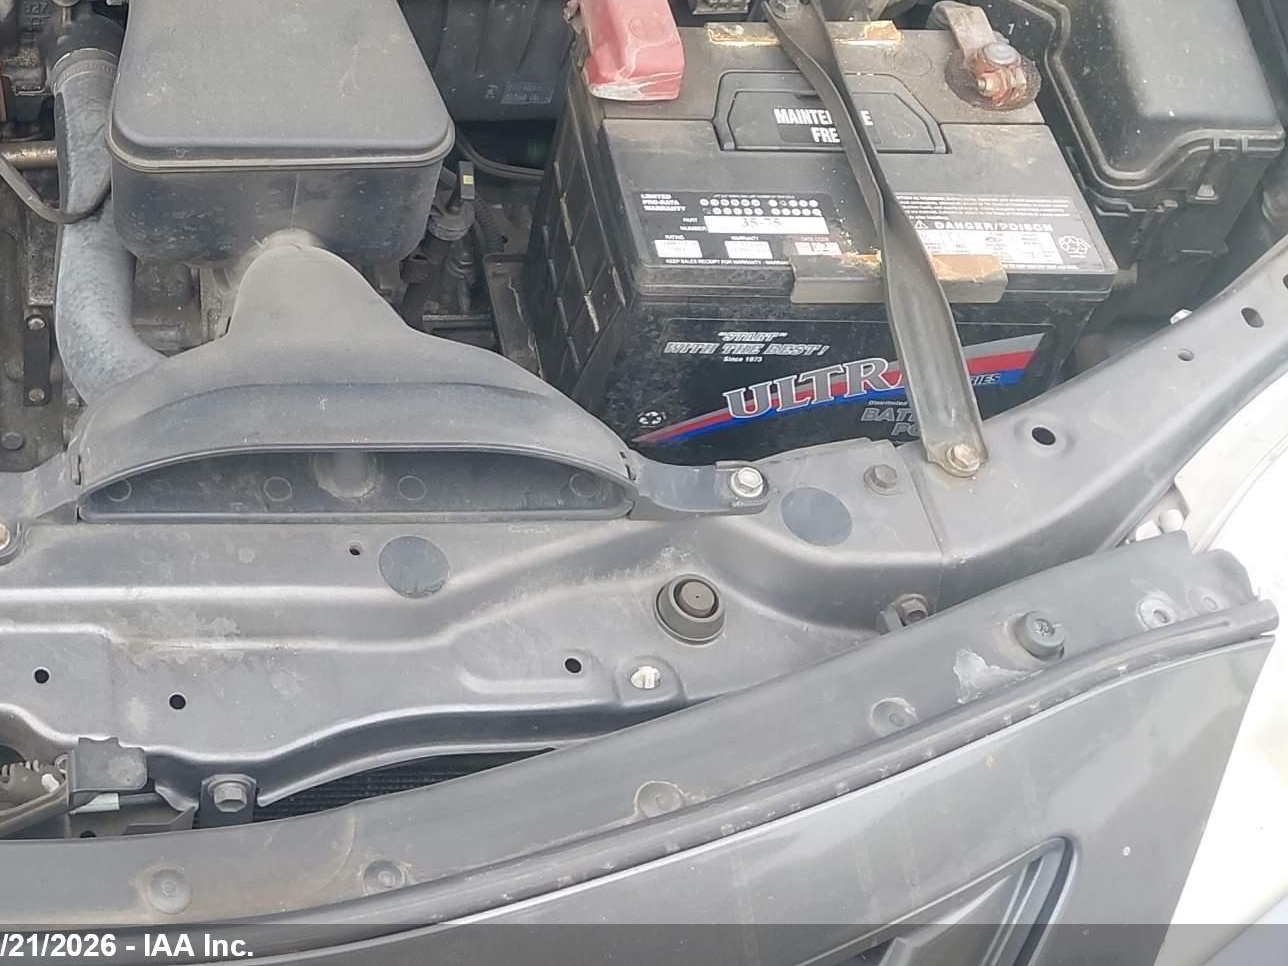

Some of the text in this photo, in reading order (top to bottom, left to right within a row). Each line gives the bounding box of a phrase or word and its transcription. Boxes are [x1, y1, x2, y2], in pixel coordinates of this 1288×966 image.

[934, 221, 1054, 232] DANGER/POISON
[664, 341, 830, 356] WITH THE BEST!
